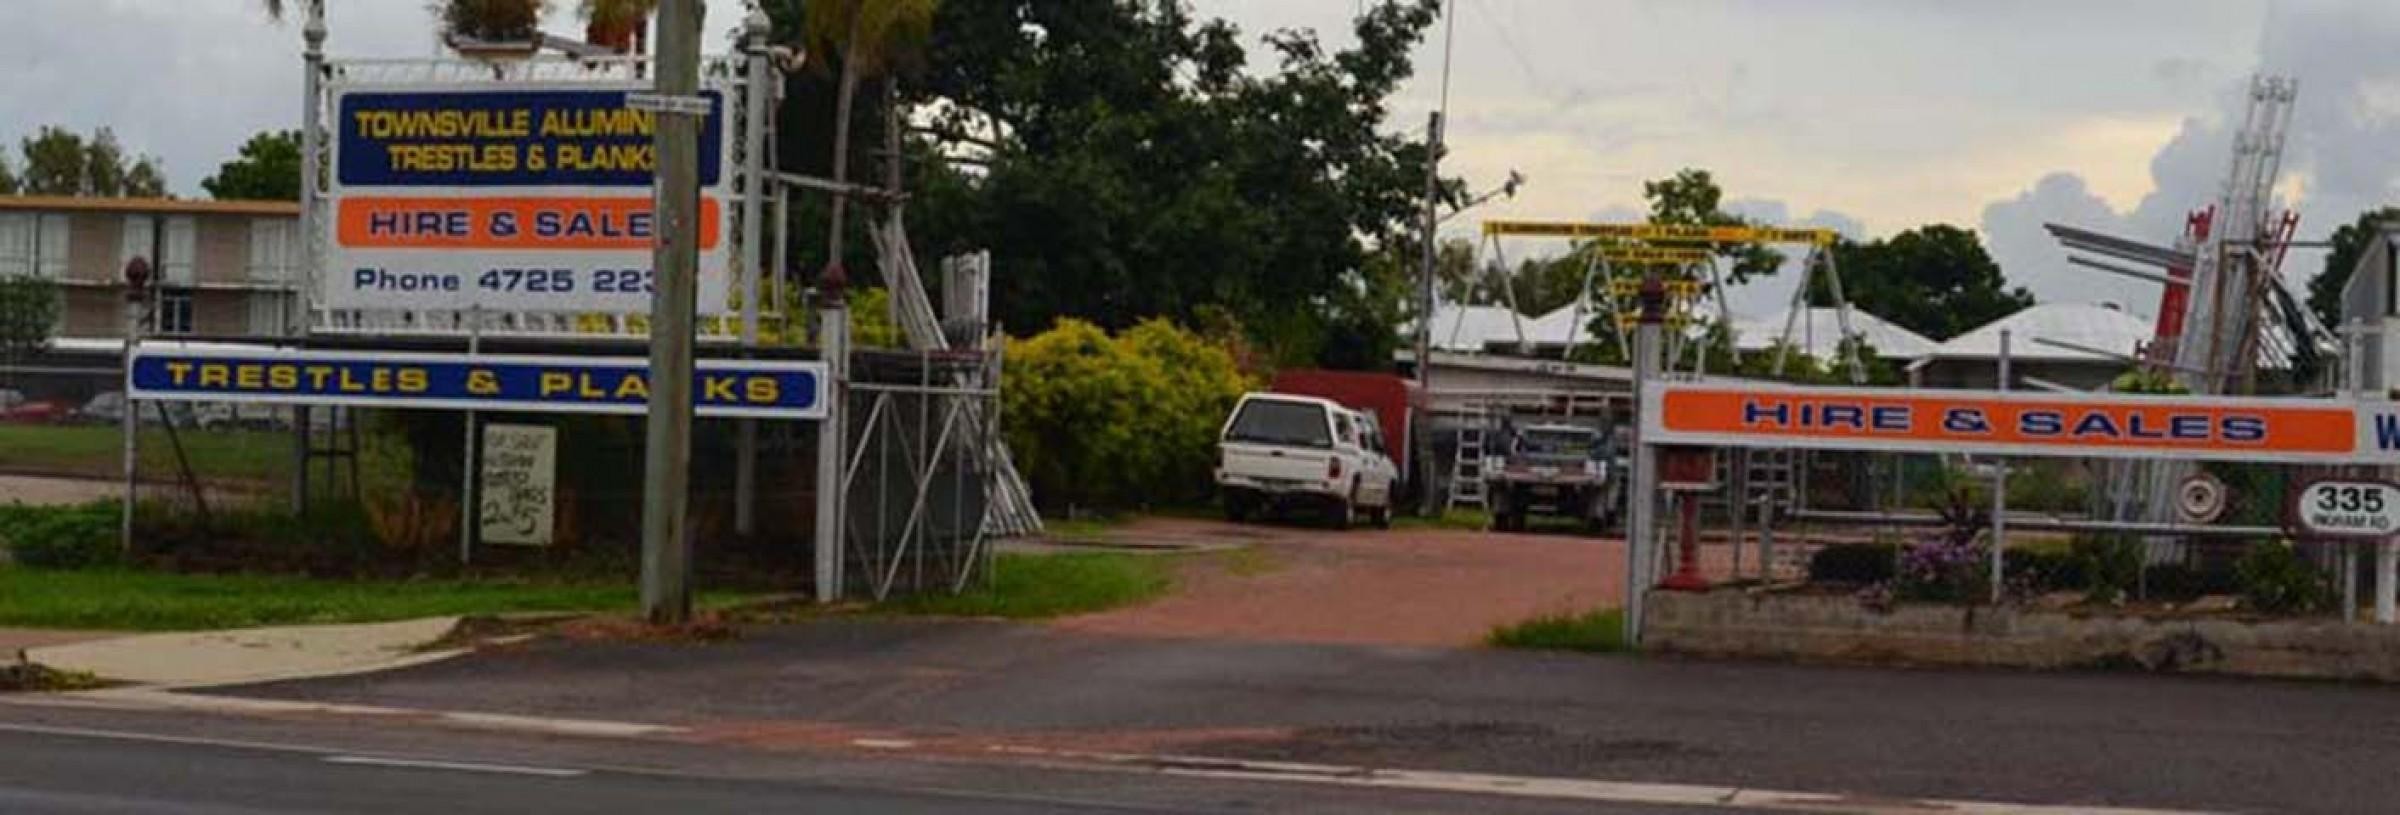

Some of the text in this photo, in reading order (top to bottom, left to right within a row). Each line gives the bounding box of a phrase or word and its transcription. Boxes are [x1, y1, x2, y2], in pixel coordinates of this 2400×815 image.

[355, 110, 702, 137] TOWNSVILLE ALUMIN
[388, 144, 517, 171] TRESTLES
[526, 144, 547, 171] &
[369, 211, 653, 238] HIRE & SALE
[354, 267, 460, 292] Phone
[478, 268, 575, 293] 4725
[166, 361, 780, 403] TRESTLES & PLAKS
[1744, 401, 2267, 441] HIRE & SALES
[2317, 486, 2384, 513] 335
